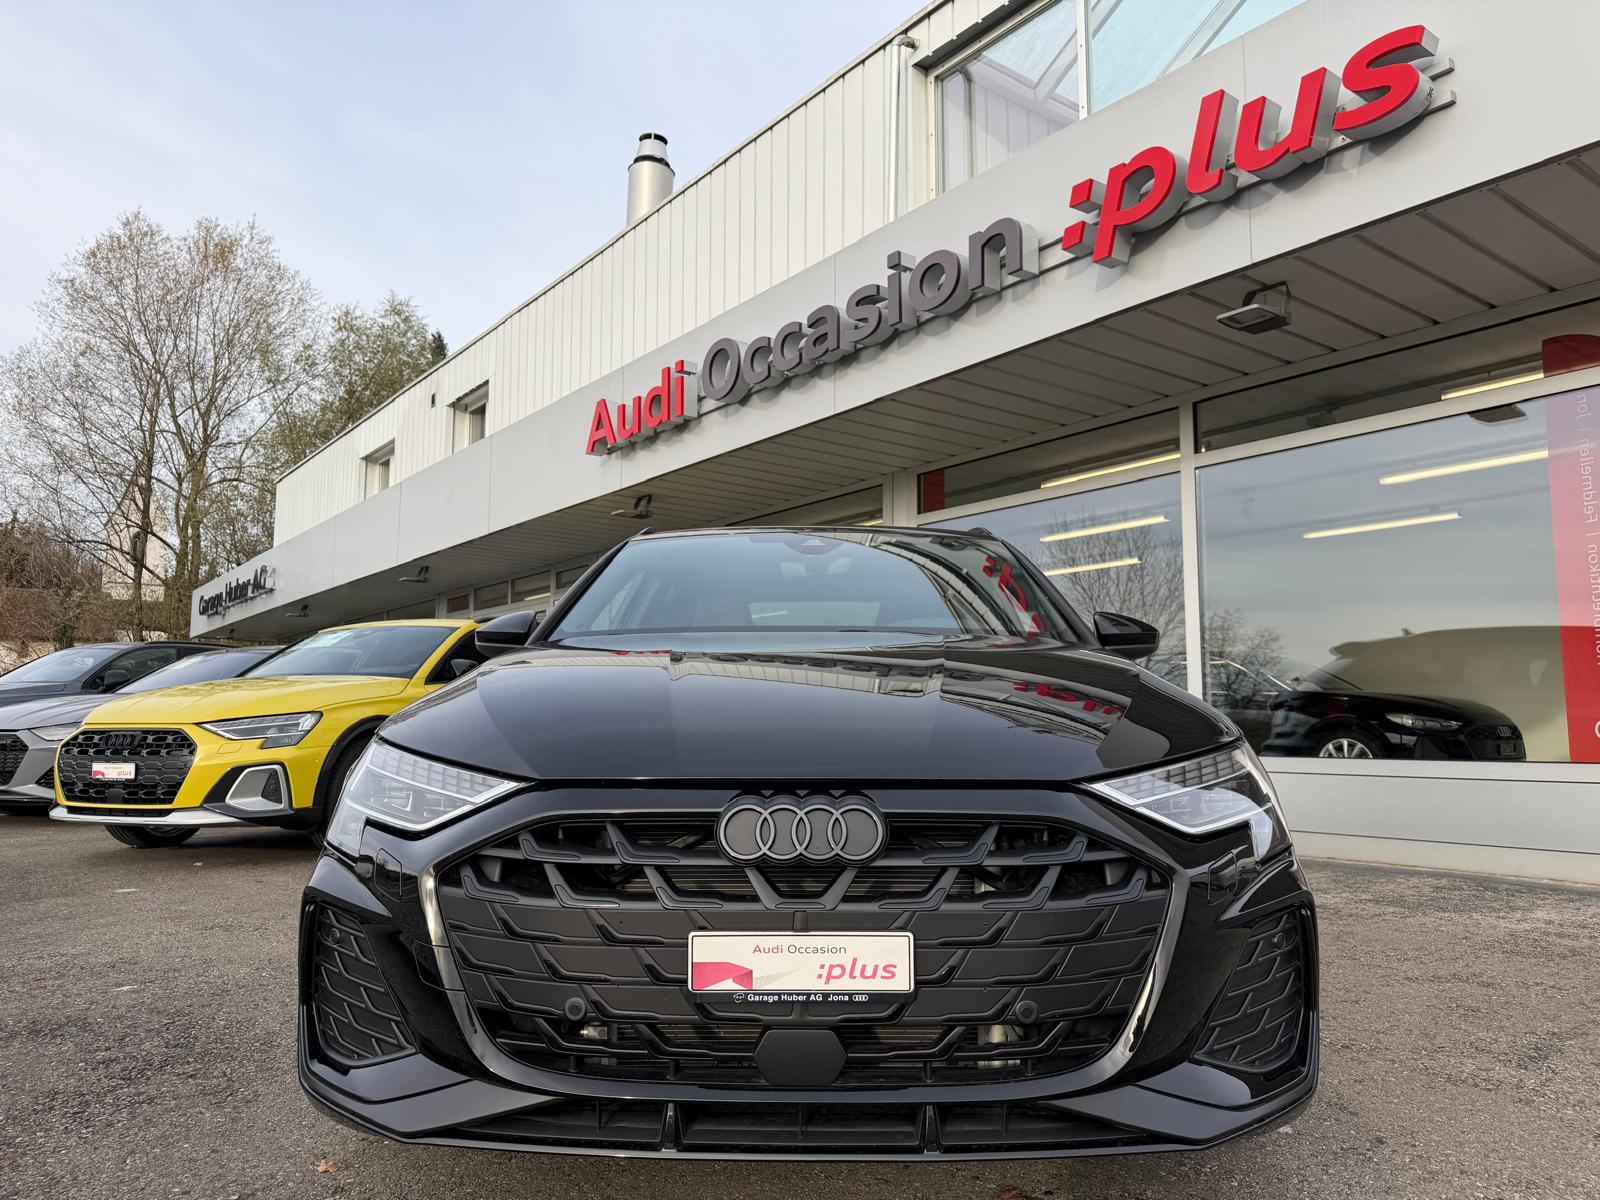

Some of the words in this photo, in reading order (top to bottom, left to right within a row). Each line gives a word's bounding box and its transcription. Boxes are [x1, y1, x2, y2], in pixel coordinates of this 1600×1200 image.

[585, 359, 688, 455] Audi
[701, 216, 1028, 402] Occasion
[198, 591, 224, 617] Garage
[224, 577, 251, 606] Huber
[250, 564, 268, 595] AG
[752, 944, 783, 955] Audi
[787, 944, 847, 955] Occasion
[816, 957, 898, 985] :plus
[747, 993, 779, 1003] Garage
[781, 993, 807, 1002] Huber
[810, 993, 823, 1002] AG
[828, 993, 849, 1002] Jona
